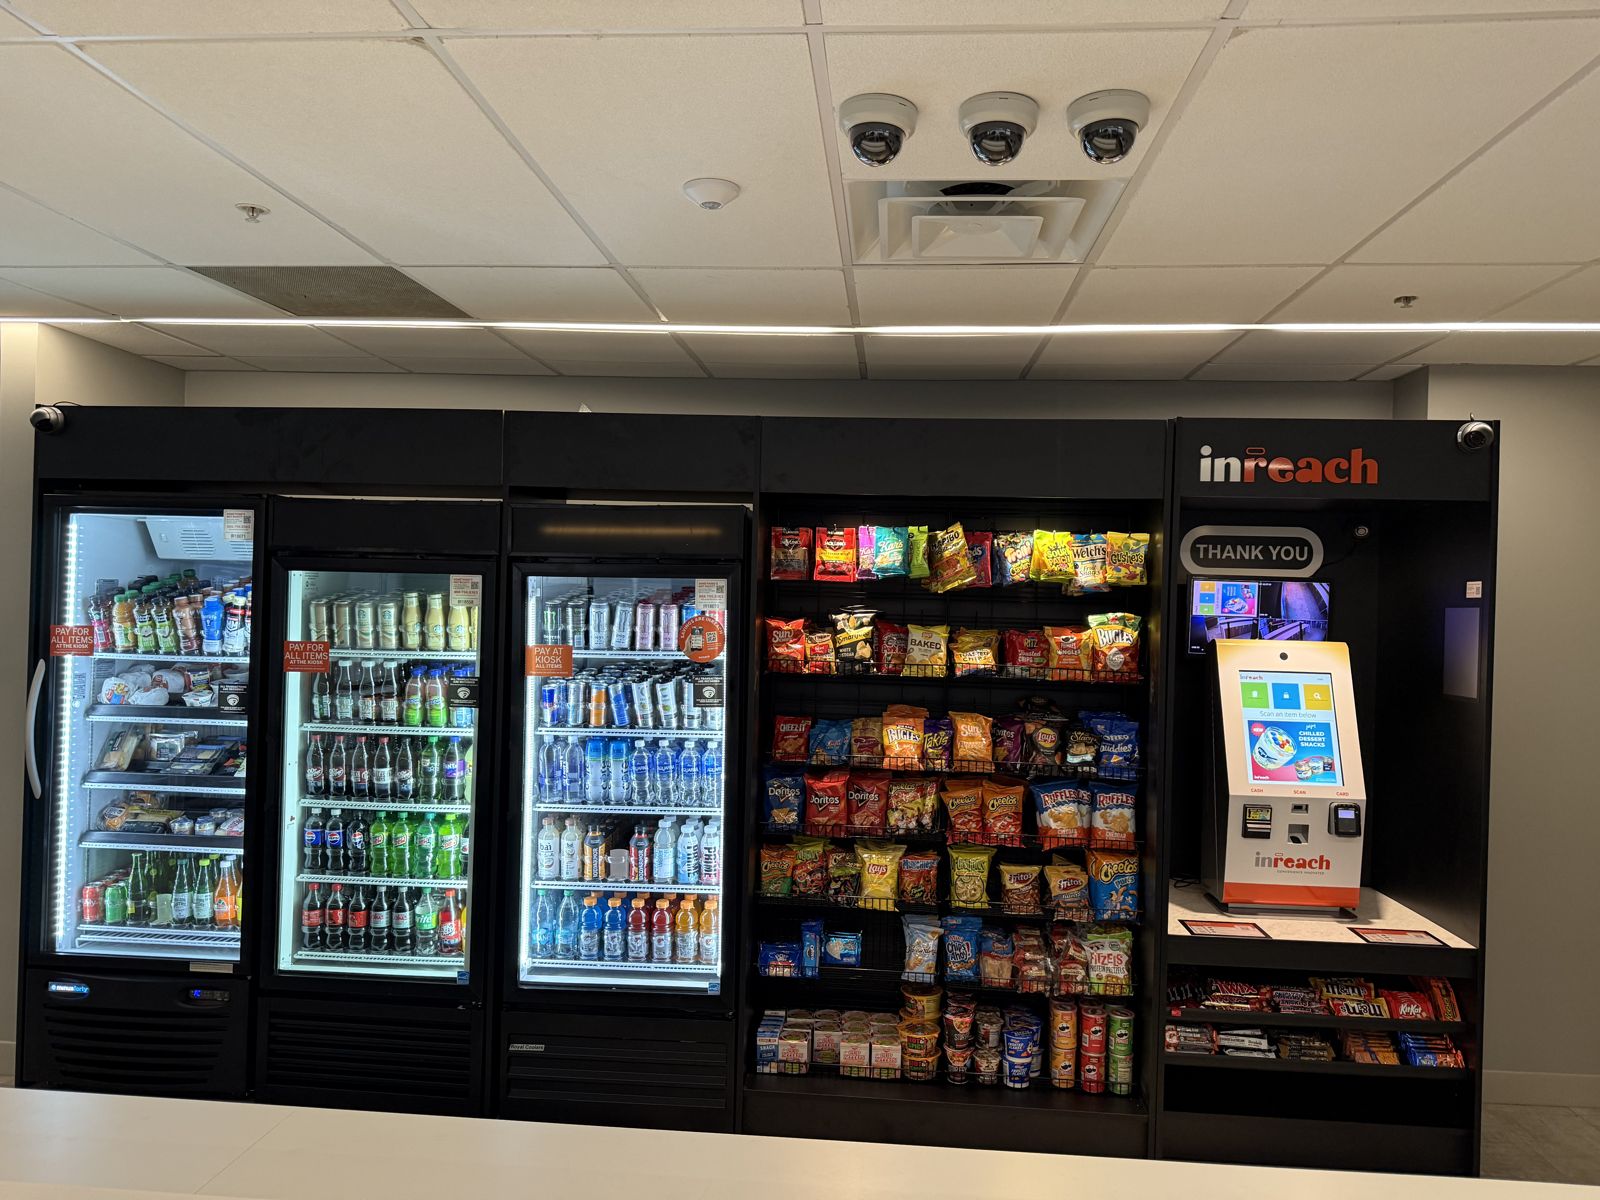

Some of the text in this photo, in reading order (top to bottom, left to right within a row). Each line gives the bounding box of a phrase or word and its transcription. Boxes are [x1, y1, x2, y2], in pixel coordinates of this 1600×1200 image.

[1200, 445, 1379, 484] inreach
[1072, 546, 1106, 559] Welch's
[1111, 552, 1144, 564] Gushers
[1196, 543, 1308, 561] THANK YOU
[69, 636, 93, 644] ITEMS
[909, 638, 941, 650] BAKED
[1097, 629, 1133, 652] BUGLES
[307, 644, 324, 652] FOR
[285, 652, 328, 660] ALL ITEMS
[887, 728, 921, 744] BUGLES
[924, 732, 949, 752] Takis
[768, 786, 800, 797] Doritos
[848, 791, 880, 800] Doritos
[988, 796, 1018, 811] Cheetos
[1040, 789, 1078, 809] RUFFLES
[1096, 793, 1136, 808] RUFFLES
[1255, 851, 1331, 871] inreach
[1101, 860, 1138, 882] Cheetos
[1058, 877, 1084, 891] Fritos
[946, 941, 966, 953] Chips
[1217, 980, 1257, 994] TWIX
